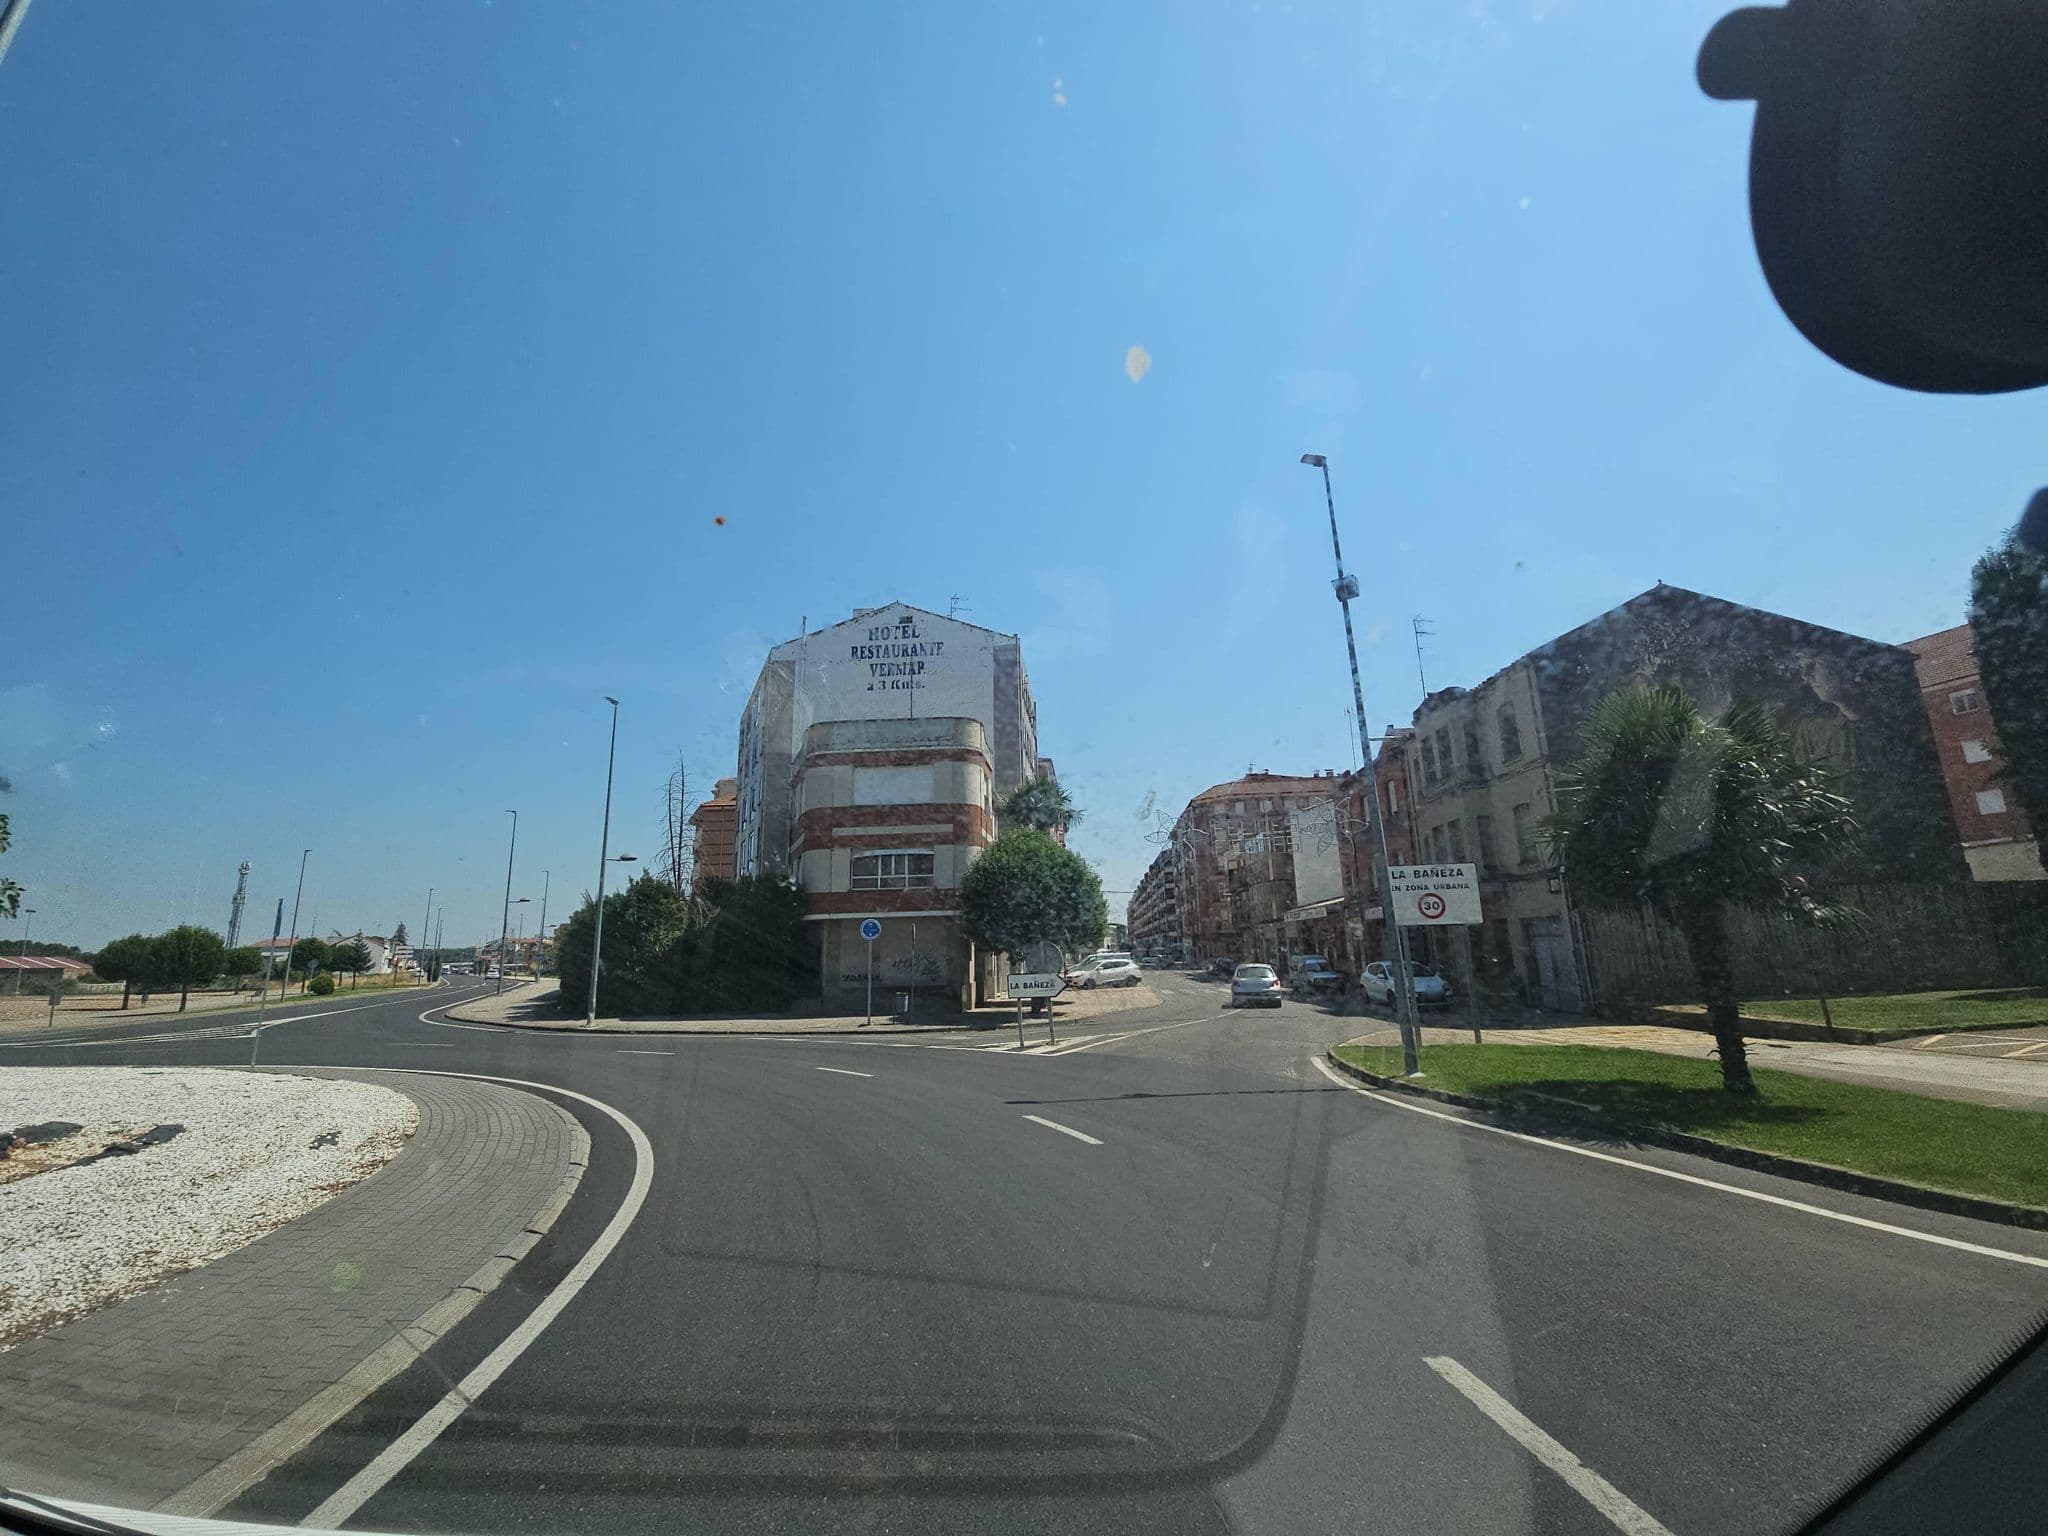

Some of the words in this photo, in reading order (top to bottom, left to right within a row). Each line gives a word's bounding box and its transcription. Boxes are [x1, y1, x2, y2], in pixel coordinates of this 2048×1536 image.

[868, 625, 921, 641] HOTEL
[851, 642, 944, 659] RESTAURANTE
[878, 681, 886, 690] 3
[1391, 871, 1407, 879] LA
[1413, 868, 1464, 879] BAÑEZA
[1433, 882, 1470, 890] URBANA
[1423, 901, 1440, 911] 30
[1023, 981, 1055, 989] BAÑEZA
